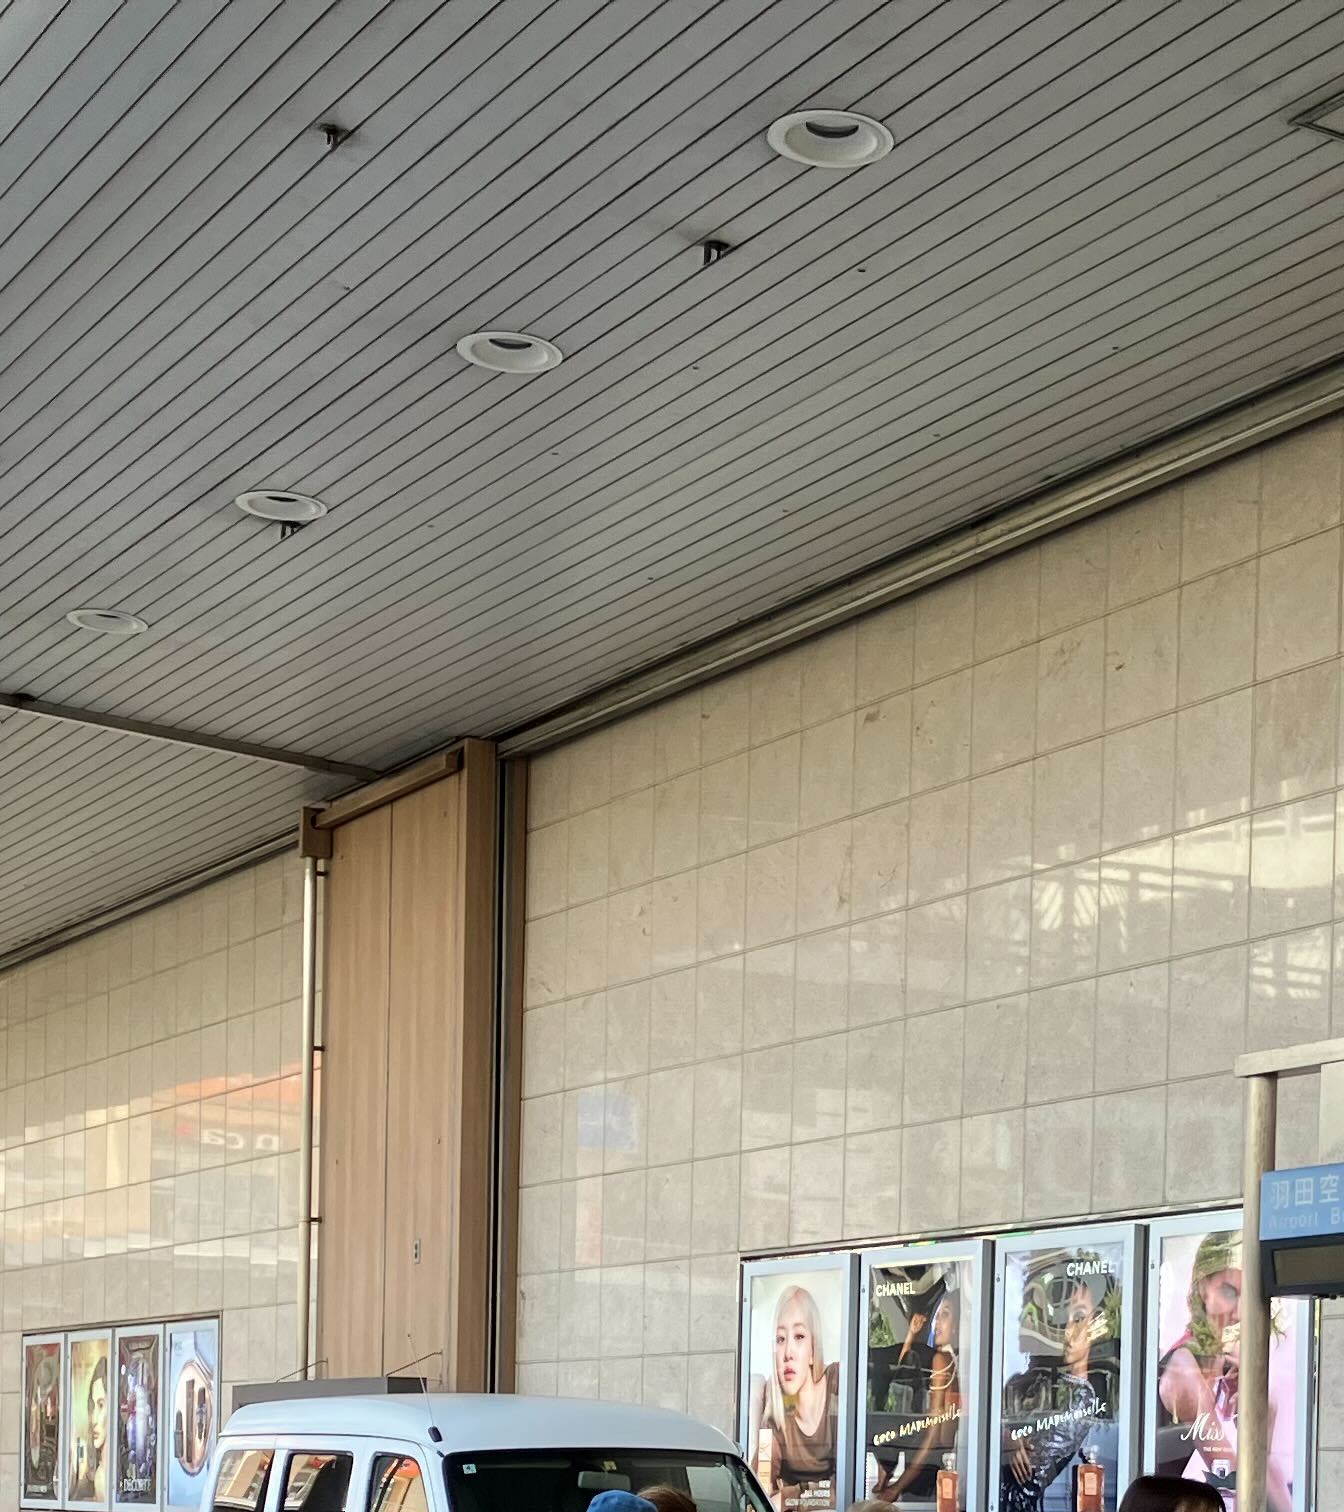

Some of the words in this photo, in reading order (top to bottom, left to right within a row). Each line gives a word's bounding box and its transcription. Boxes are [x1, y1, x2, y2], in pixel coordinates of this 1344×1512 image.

[1268, 1211, 1318, 1229] Airport
[1066, 1259, 1114, 1277] CHANEL
[875, 1282, 916, 1297] CHANEL
[1180, 1412, 1225, 1441] Miss
